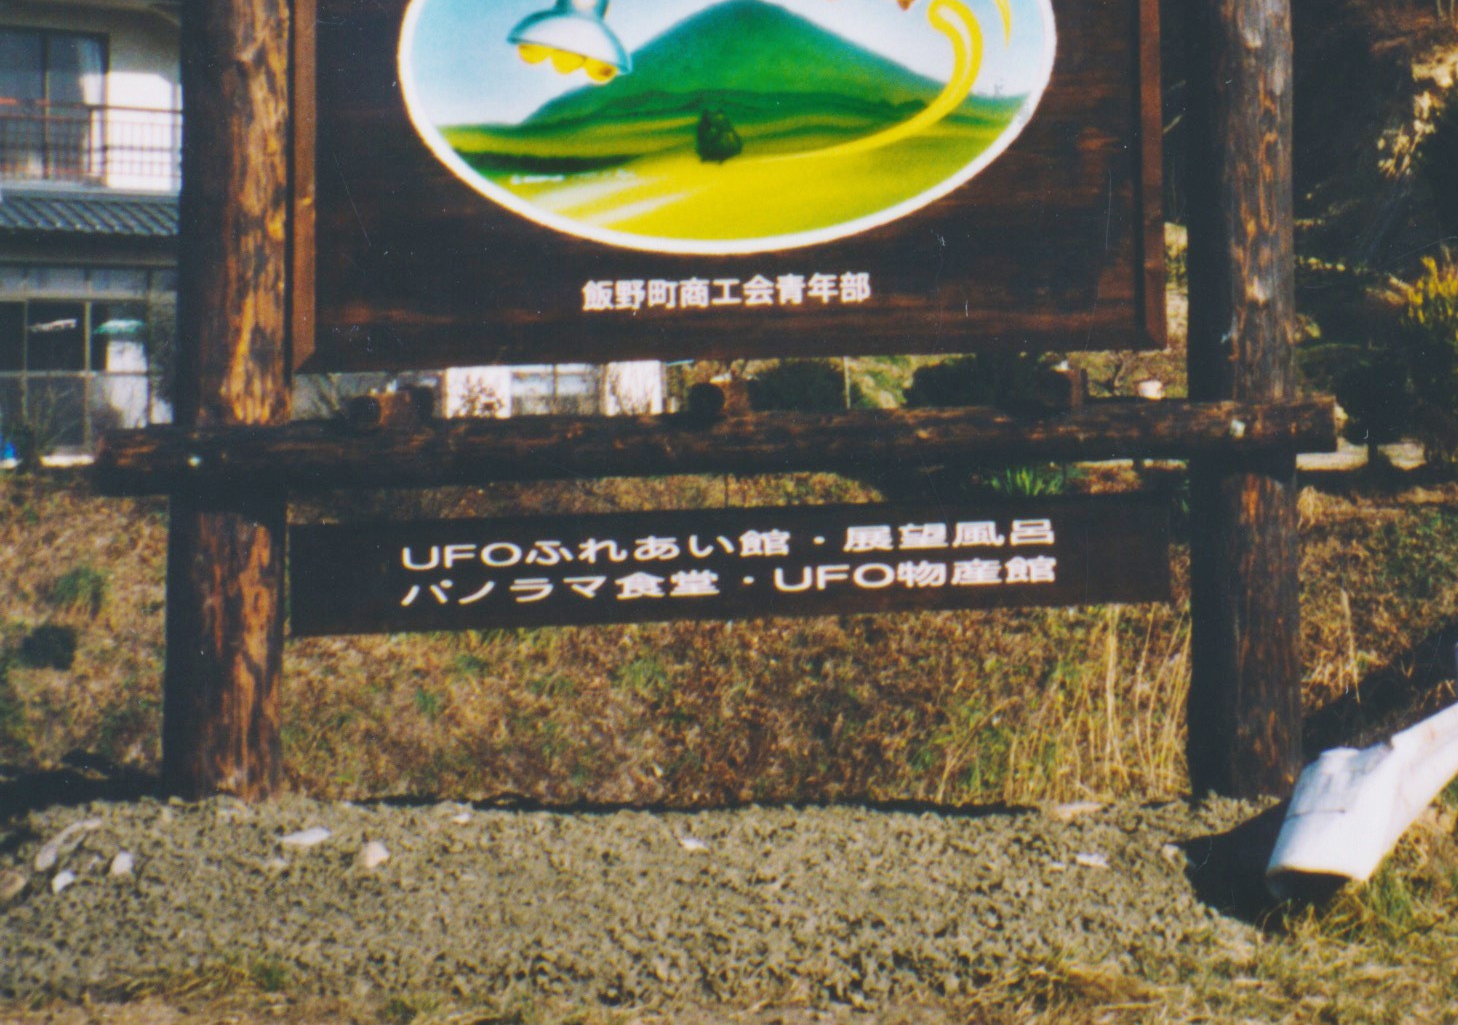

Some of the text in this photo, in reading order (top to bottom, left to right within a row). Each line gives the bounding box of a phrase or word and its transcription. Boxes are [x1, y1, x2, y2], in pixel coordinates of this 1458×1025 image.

[581, 271, 872, 312] 飯野町商工会青年部
